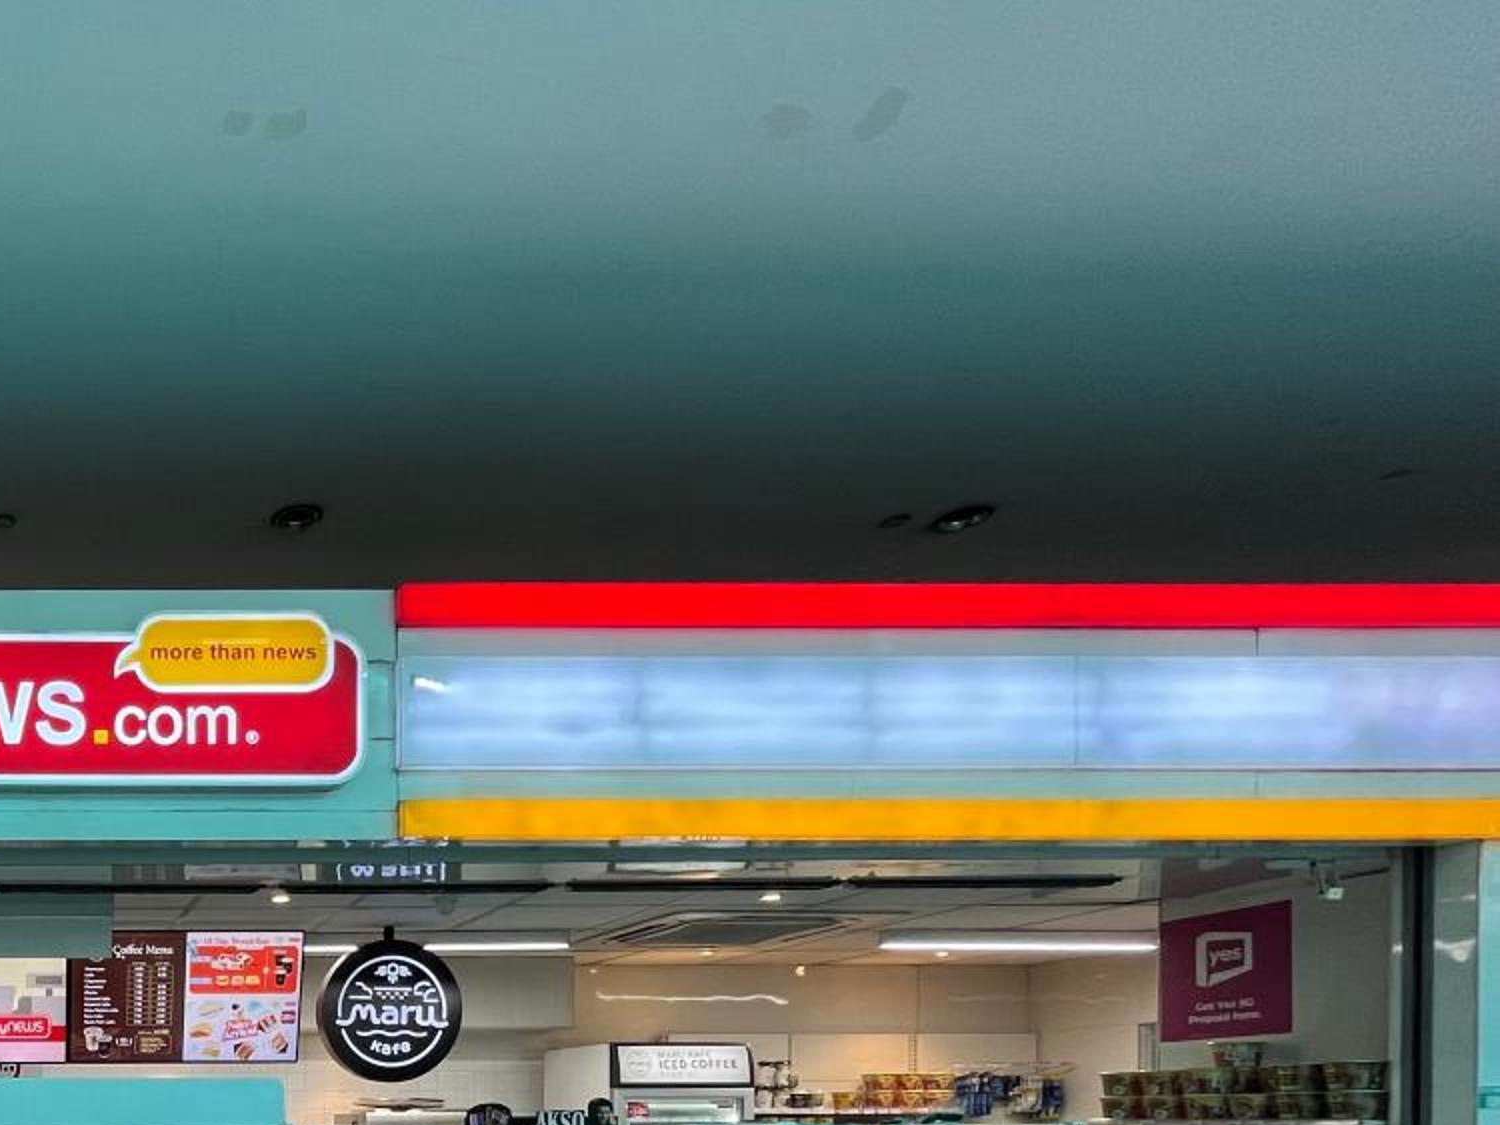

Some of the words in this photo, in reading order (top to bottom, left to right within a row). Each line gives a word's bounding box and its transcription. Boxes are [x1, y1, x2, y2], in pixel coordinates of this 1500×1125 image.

[149, 645, 204, 661] more
[209, 641, 257, 661] than
[262, 645, 317, 661] news
[1208, 947, 1243, 967] yes
[336, 1003, 449, 1028] maru
[370, 1039, 412, 1055] kafe
[659, 1059, 688, 1069] ICED
[691, 1058, 739, 1069] COFFEE
